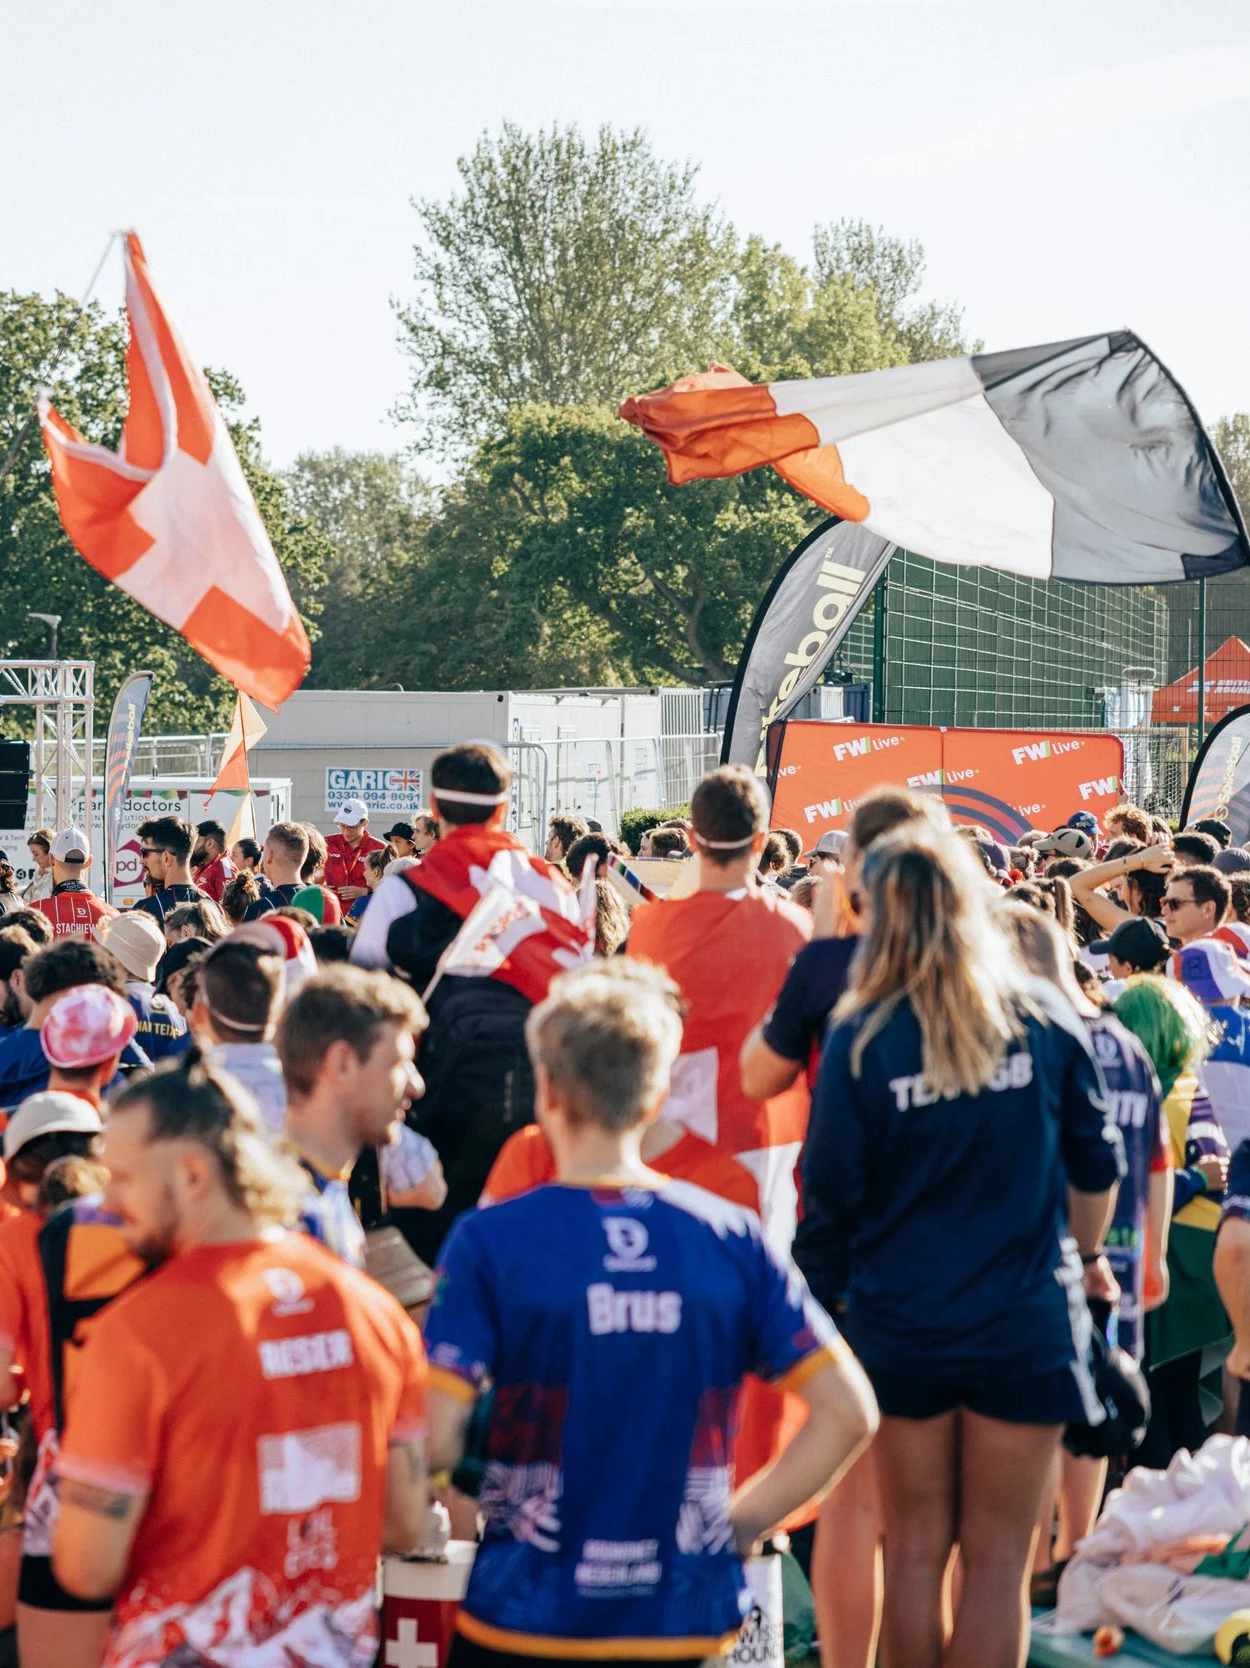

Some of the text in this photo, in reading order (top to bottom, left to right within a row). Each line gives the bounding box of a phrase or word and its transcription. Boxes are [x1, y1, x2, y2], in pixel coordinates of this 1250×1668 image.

[833, 736, 900, 761] FW Live
[1011, 740, 1081, 765] FW Live
[330, 770, 399, 790] GARIC
[946, 768, 975, 784] Live
[328, 791, 359, 800] 0330
[363, 792, 386, 801] 094
[1078, 775, 1117, 800] FW
[123, 800, 181, 812] doctors
[803, 798, 841, 823] FW
[116, 858, 137, 874] pd
[587, 1282, 682, 1335] Brus
